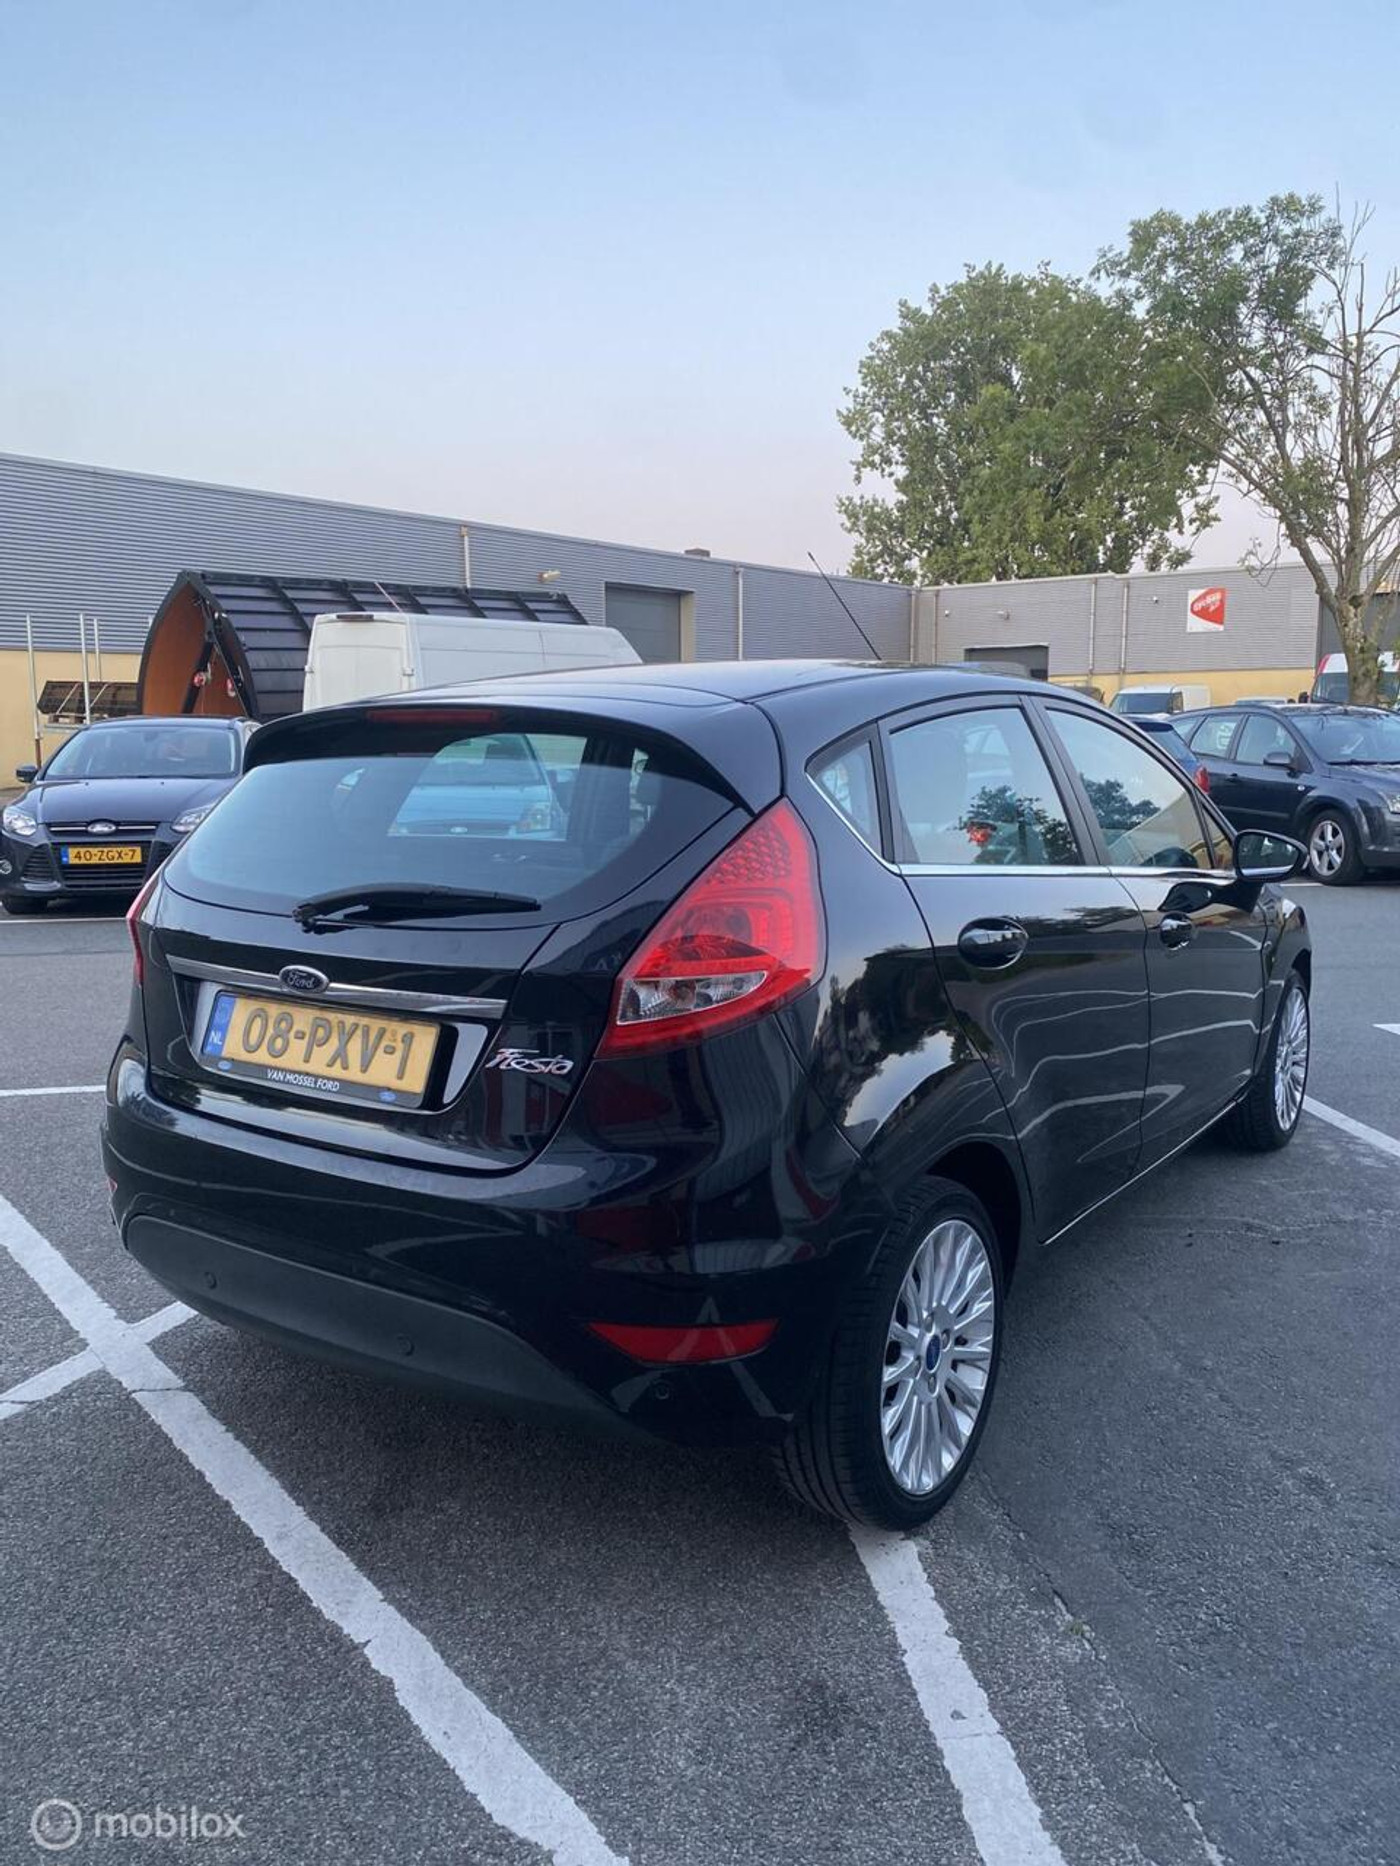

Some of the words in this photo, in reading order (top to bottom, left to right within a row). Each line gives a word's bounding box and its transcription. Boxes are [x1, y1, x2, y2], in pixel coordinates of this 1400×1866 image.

[73, 849, 137, 862] 40-ZGX-7
[287, 970, 315, 989] Ford
[208, 1030, 223, 1045] NL
[242, 1007, 415, 1081] 08-PXV-1
[485, 1048, 575, 1075] Fiesta
[267, 1068, 285, 1081] VAN
[285, 1072, 315, 1088] MOSSEL
[316, 1078, 340, 1092] FORD
